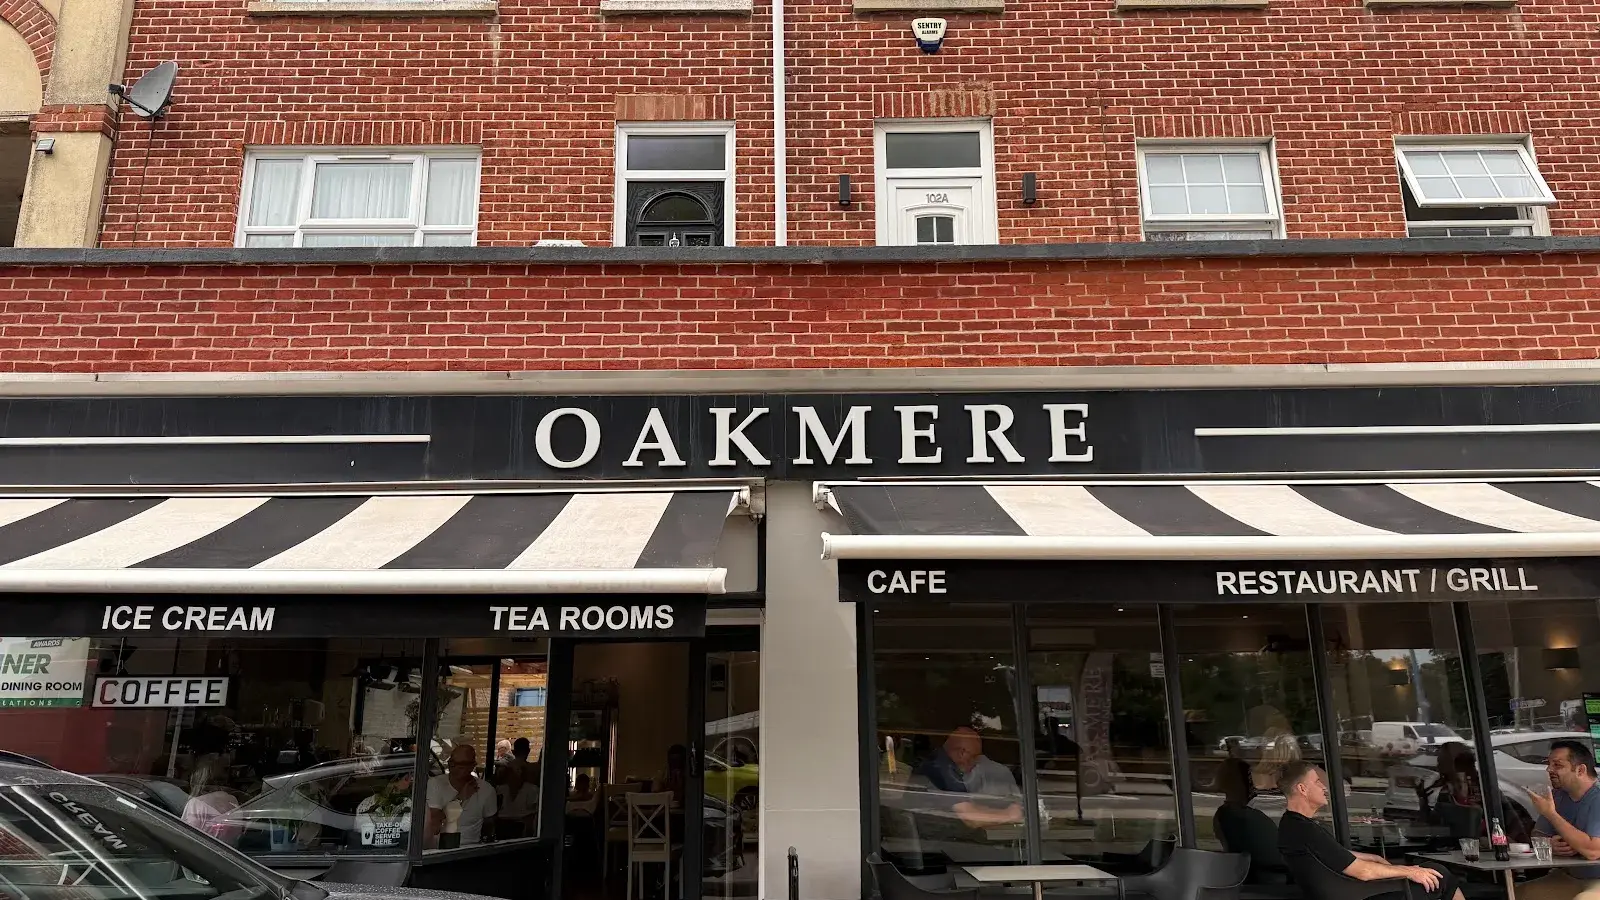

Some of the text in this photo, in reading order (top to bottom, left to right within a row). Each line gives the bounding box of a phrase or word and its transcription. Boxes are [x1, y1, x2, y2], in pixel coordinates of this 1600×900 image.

[926, 193, 949, 204] 102A
[536, 404, 1094, 469] OAKMERE
[867, 570, 947, 594] CAFE
[1217, 569, 1420, 595] RESTAURANT
[1447, 567, 1538, 592] GRILL
[101, 605, 276, 631] ICE CREAM
[490, 605, 674, 631] TEA ROOMS
[33, 640, 61, 648] AWARDS
[1, 682, 82, 691] DINING ROOM
[100, 679, 223, 704] COFFEE
